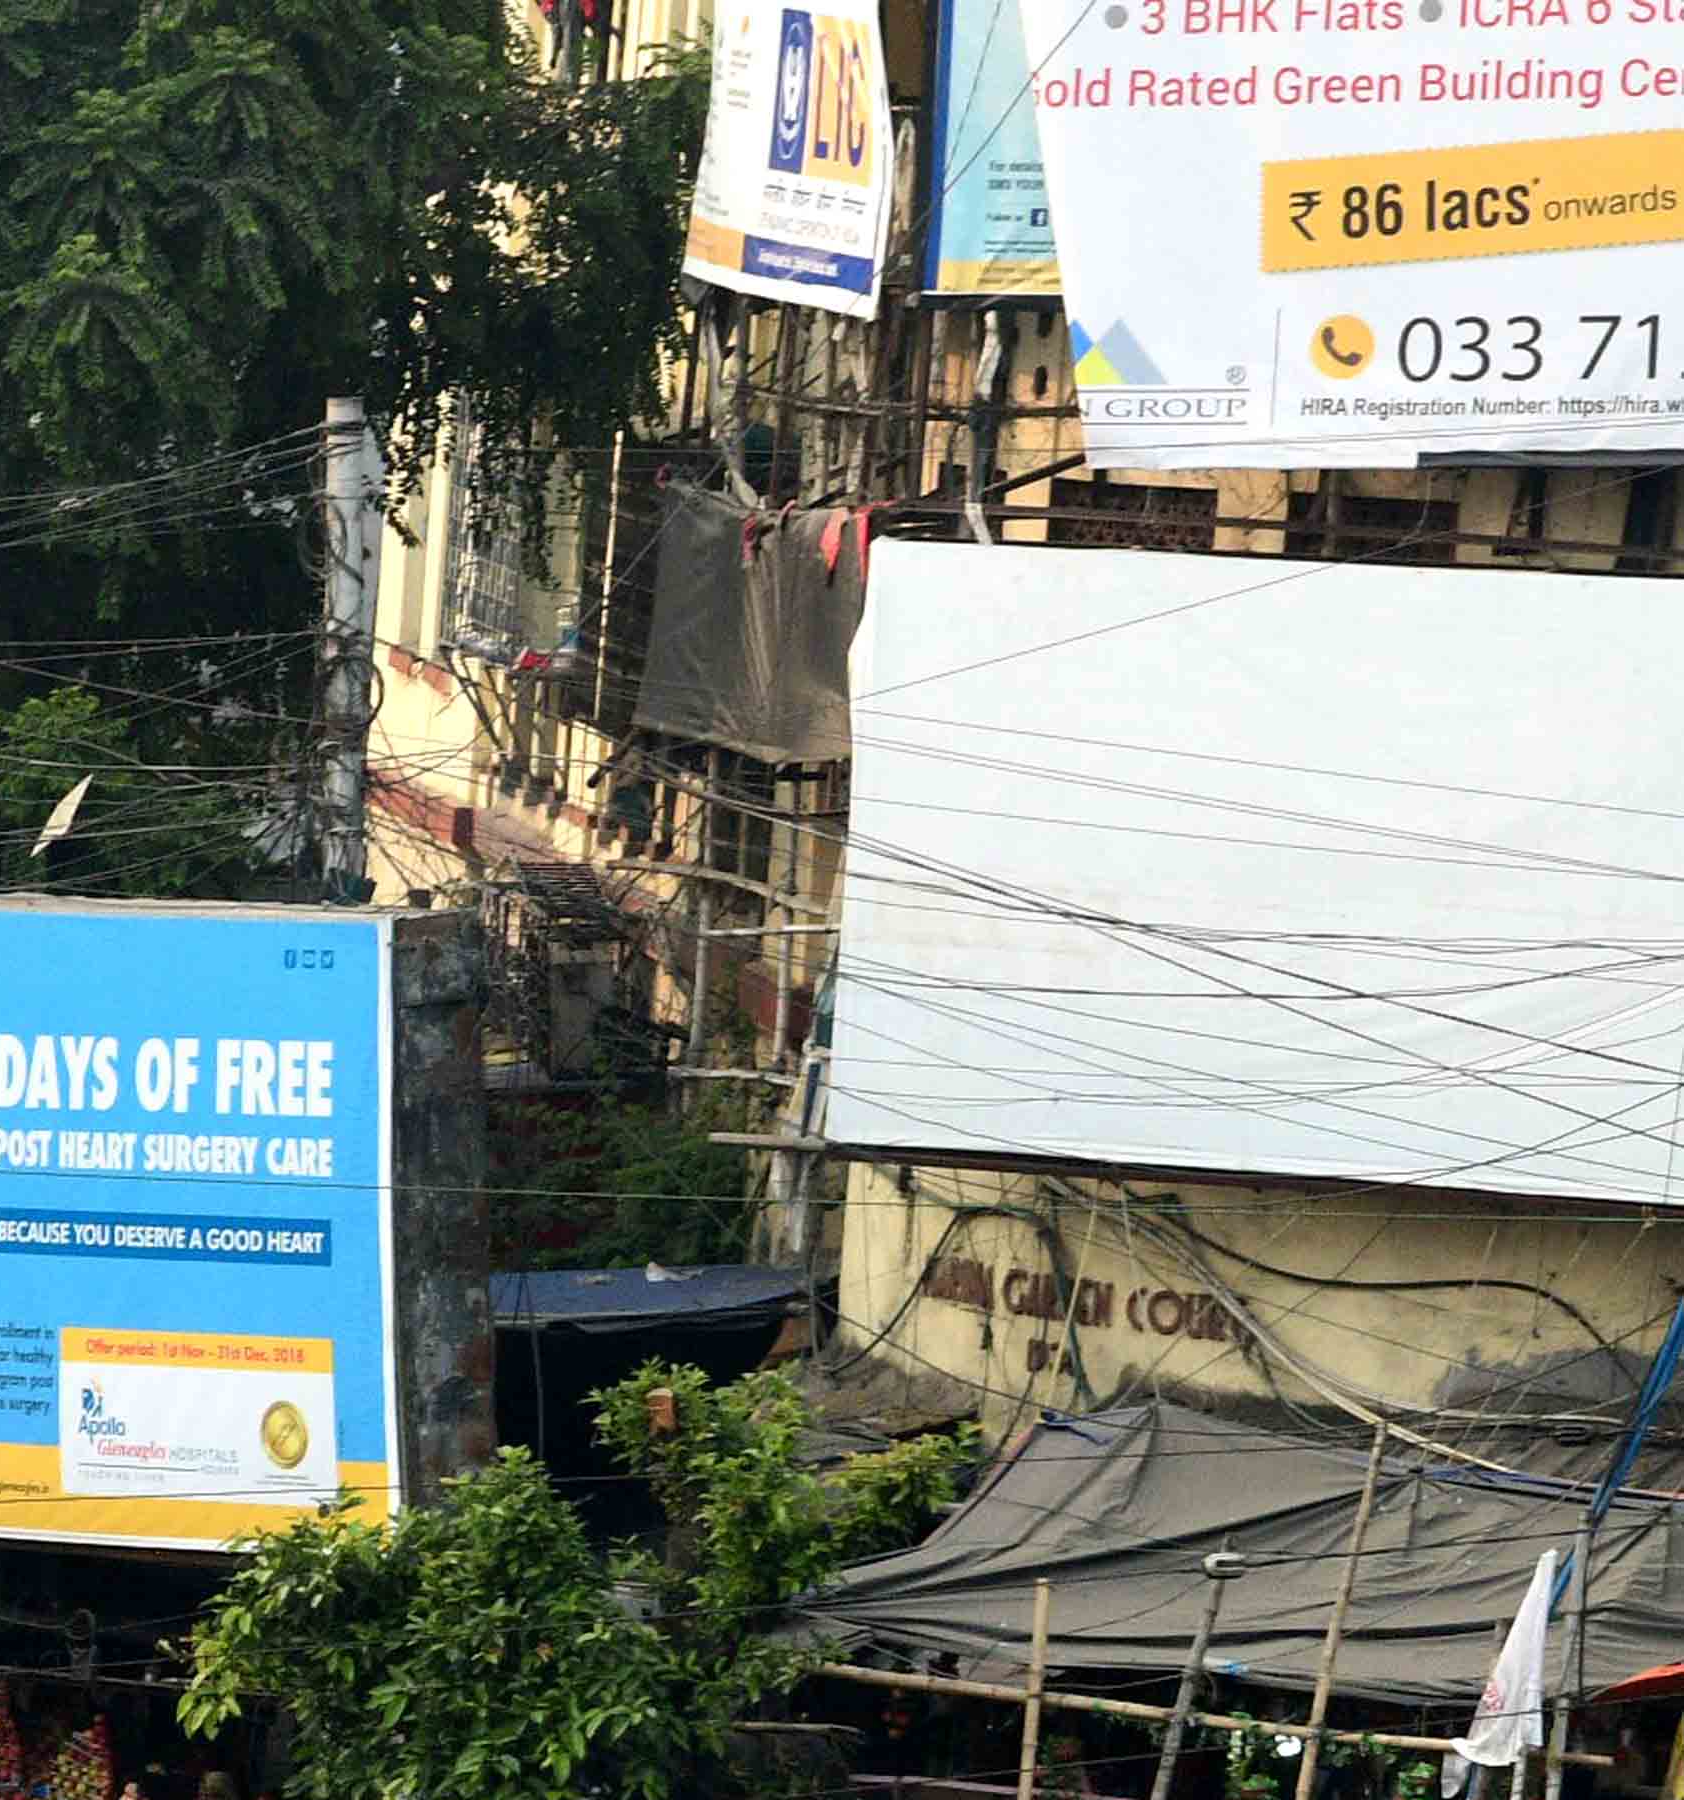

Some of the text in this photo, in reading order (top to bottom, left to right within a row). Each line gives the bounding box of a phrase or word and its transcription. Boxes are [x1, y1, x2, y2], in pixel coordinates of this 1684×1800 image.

[1141, 0, 1404, 35] 3 BHK Flats
[1458, 0, 1569, 28] ICRA
[814, 20, 868, 168] LIC
[1129, 67, 1257, 107] Rated
[1273, 65, 1401, 104] Green
[1420, 59, 1603, 109] Building
[1621, 58, 1684, 97] Ce
[1342, 183, 1404, 239] 86
[1543, 185, 1677, 221] onwards
[1398, 314, 1684, 383] 033 71
[1104, 397, 1247, 420] GROUP
[1300, 398, 1347, 417] HIRA
[1353, 396, 1465, 419] Registration
[1472, 396, 1552, 417] Number:
[135, 1037, 200, 1113] OF
[215, 1039, 333, 1117] FREE
[58, 1130, 137, 1172] HEART
[143, 1133, 260, 1175] SURGERY
[265, 1138, 333, 1178] CARE
[73, 1223, 111, 1247] YOU
[113, 1224, 187, 1249] DESERVE
[188, 1228, 204, 1250] A
[206, 1229, 263, 1252] GOOD
[266, 1230, 324, 1255] HEART
[86, 1338, 114, 1355] Offer
[78, 1414, 126, 1444] Apollo
